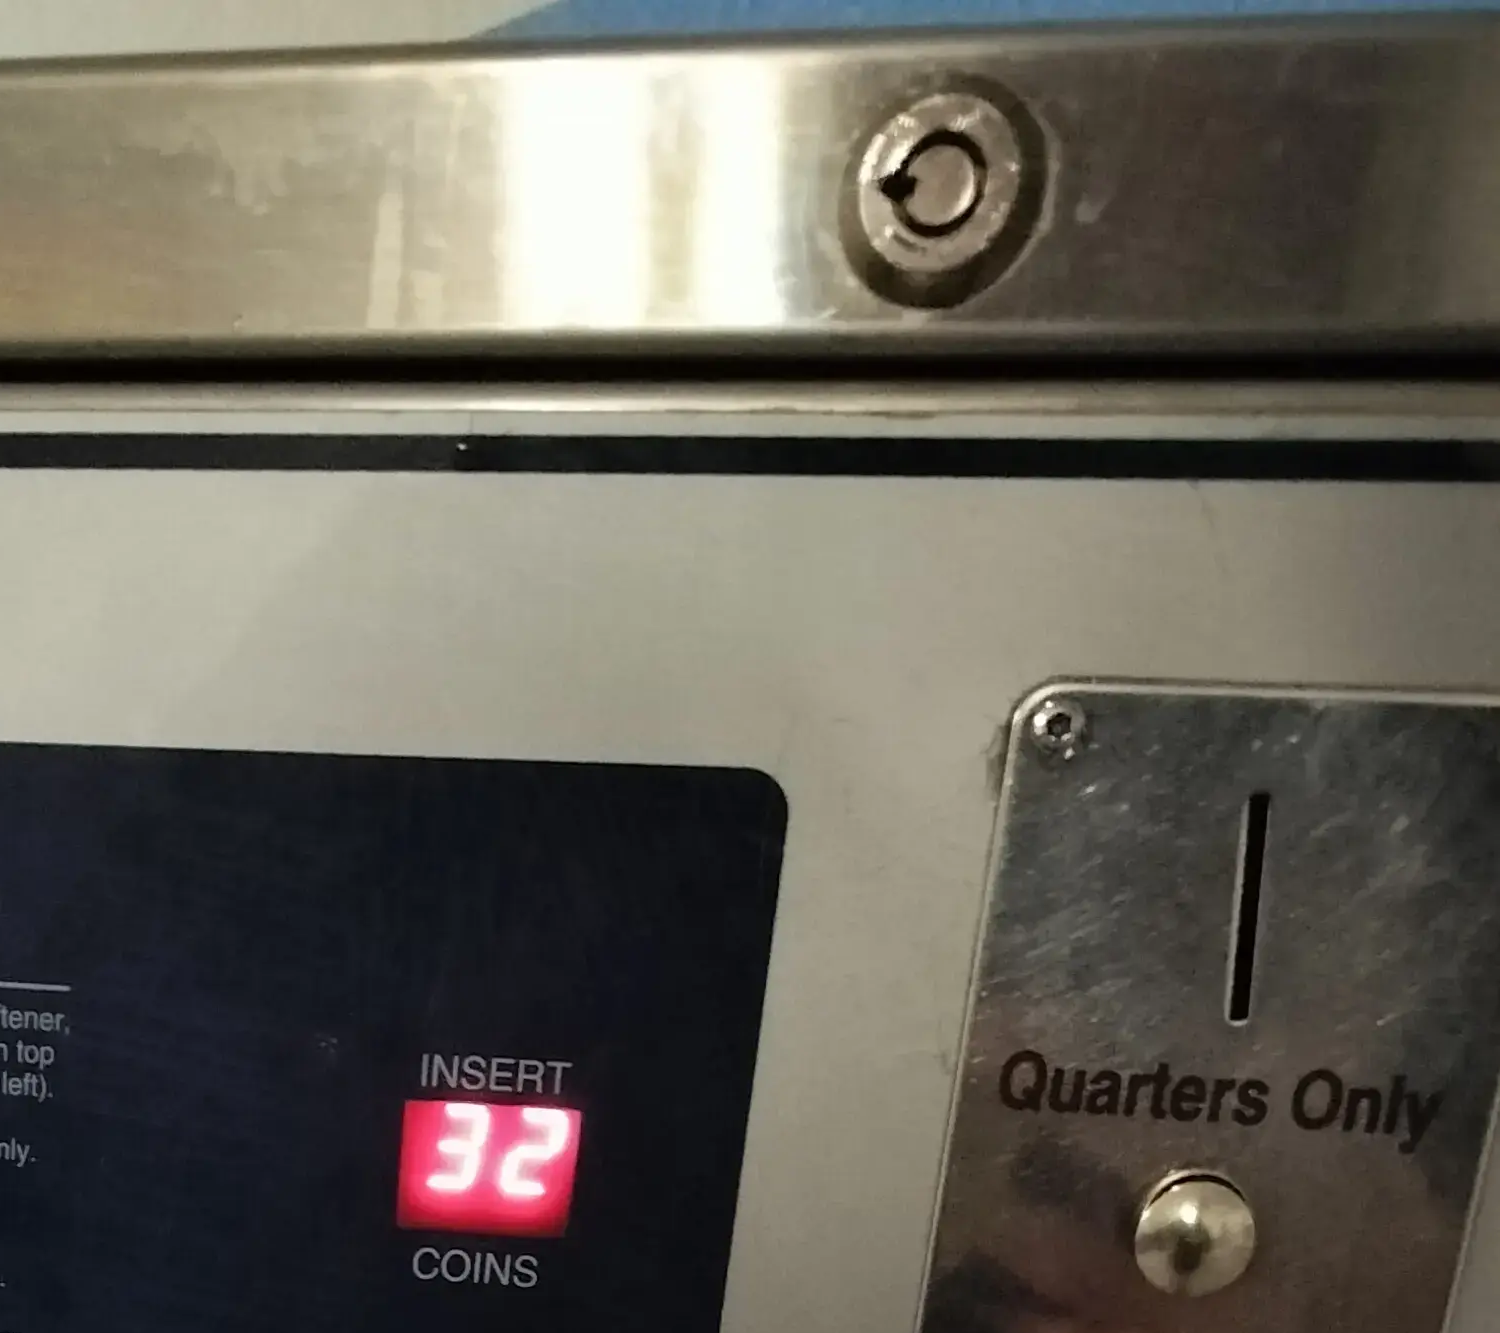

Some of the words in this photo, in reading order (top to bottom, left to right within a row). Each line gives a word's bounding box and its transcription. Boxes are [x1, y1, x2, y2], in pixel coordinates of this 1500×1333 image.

[16, 1039, 56, 1068] top
[1, 1069, 55, 1103] left).
[420, 1054, 573, 1095] INSERT
[1001, 1050, 1270, 1126] Quarters
[1292, 1068, 1443, 1154] Only
[426, 1102, 569, 1196] 32
[412, 1247, 538, 1288] COINS
